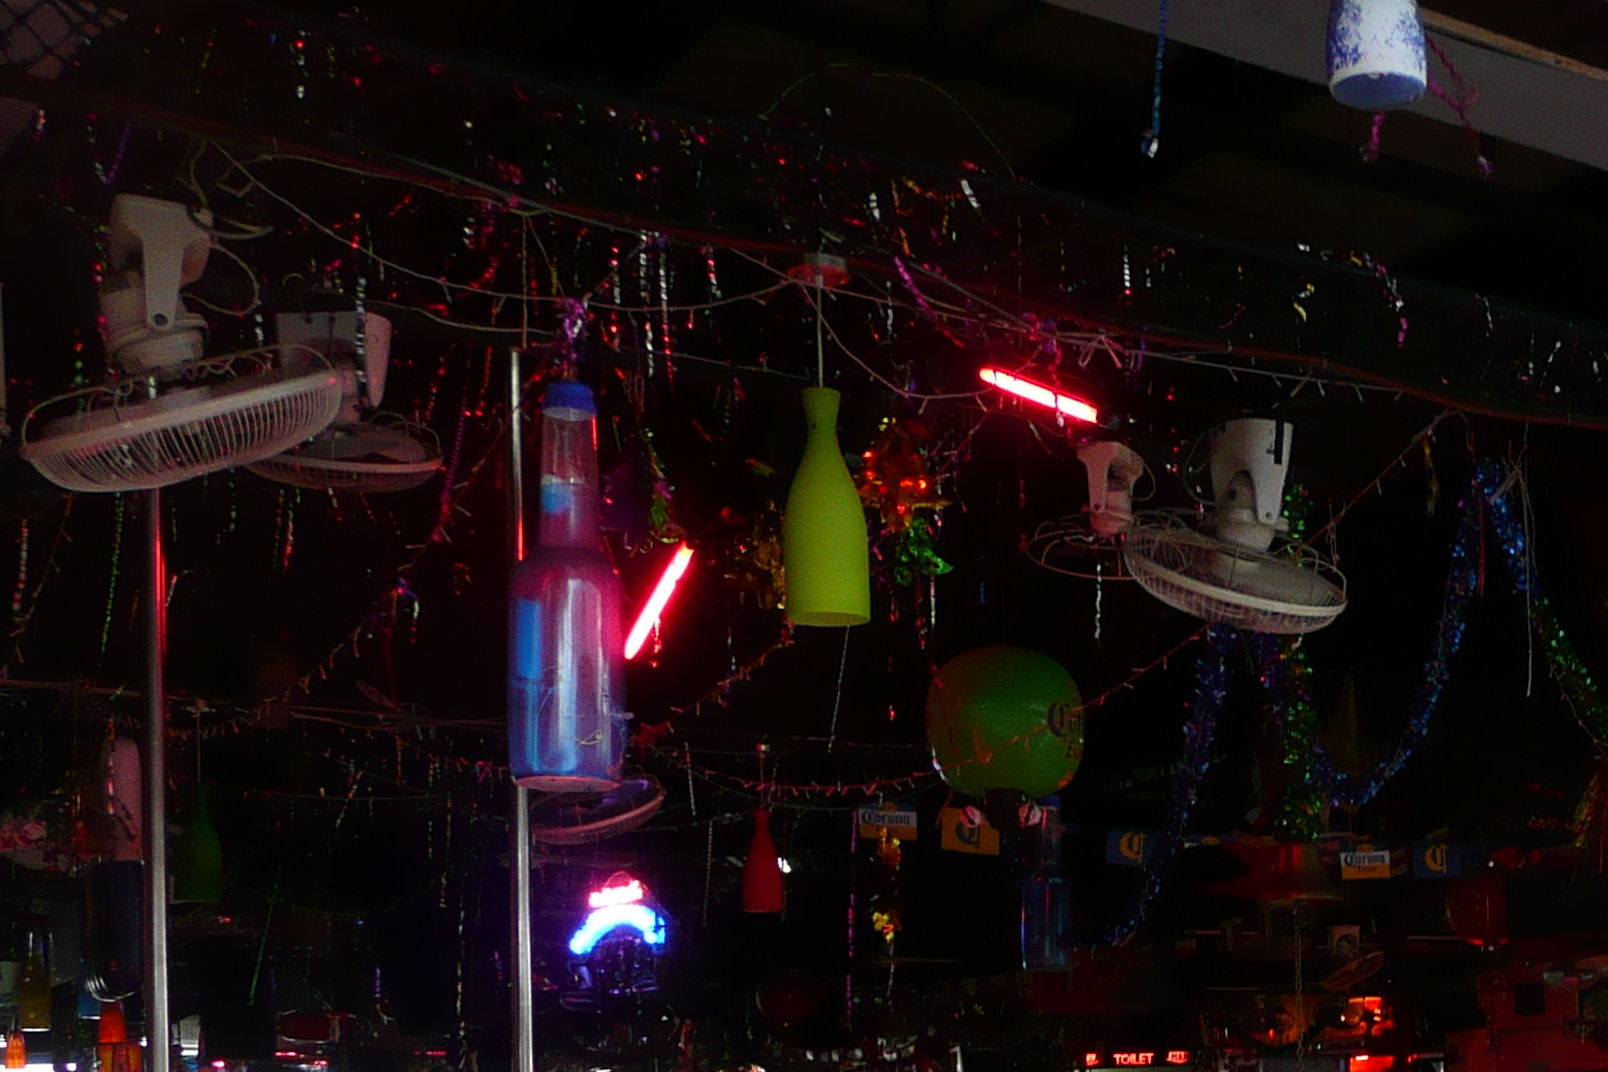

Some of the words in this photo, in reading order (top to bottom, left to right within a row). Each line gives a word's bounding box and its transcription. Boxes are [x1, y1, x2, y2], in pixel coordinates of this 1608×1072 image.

[861, 810, 911, 825] Corona
[1344, 853, 1386, 866] Corona
[1113, 1053, 1155, 1065] TOILET
